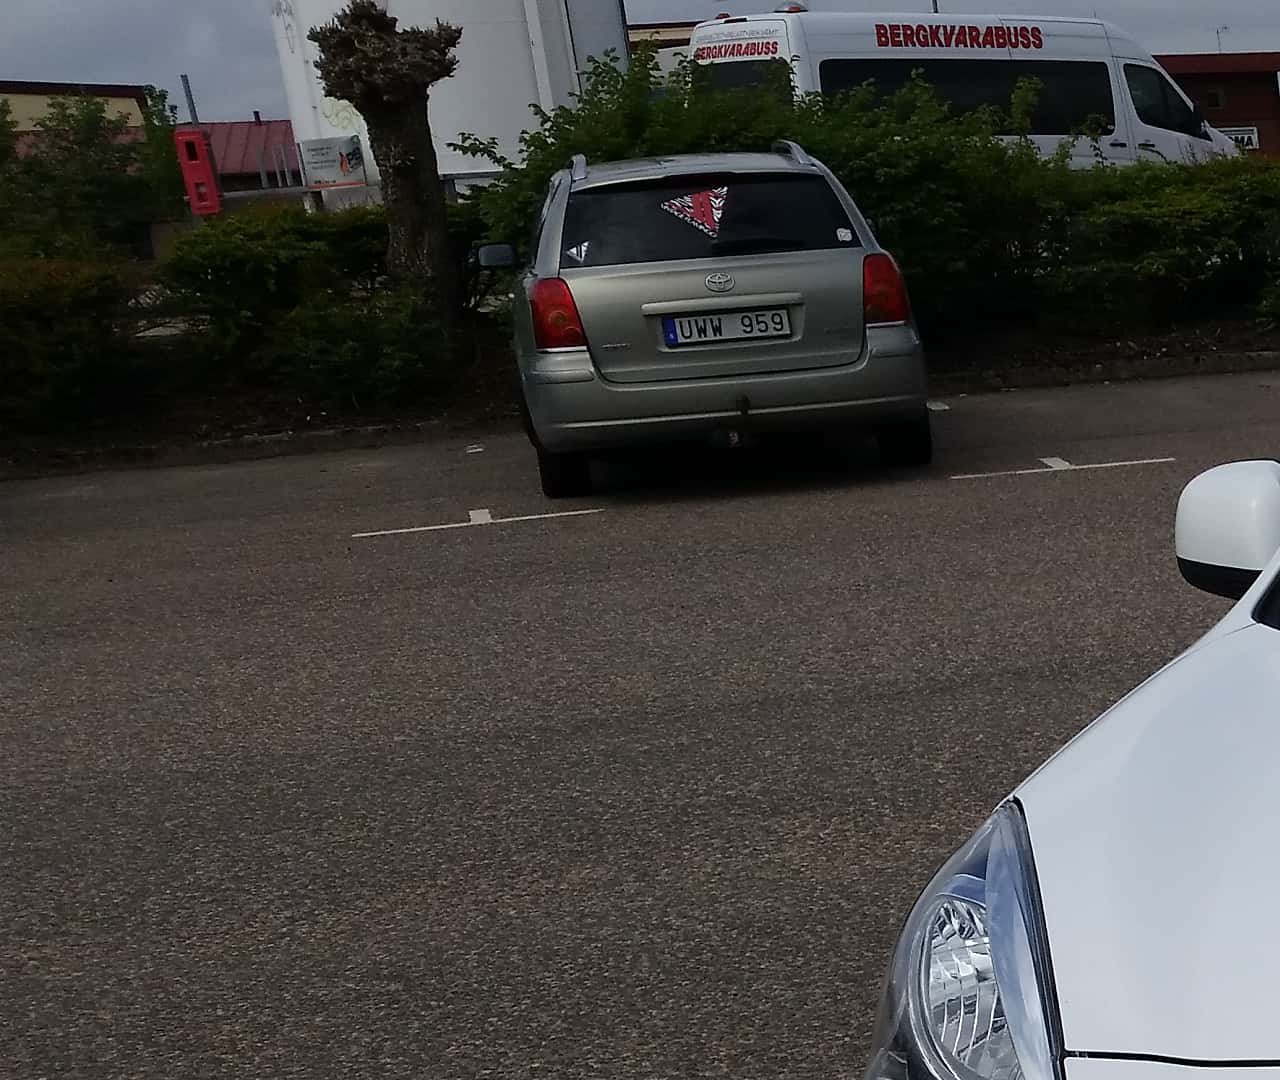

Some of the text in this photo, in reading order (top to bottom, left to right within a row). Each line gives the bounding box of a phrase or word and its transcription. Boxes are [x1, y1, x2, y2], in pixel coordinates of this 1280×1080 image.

[874, 24, 1043, 48] BERGKVARABUSS
[680, 312, 784, 339] UWW 959
